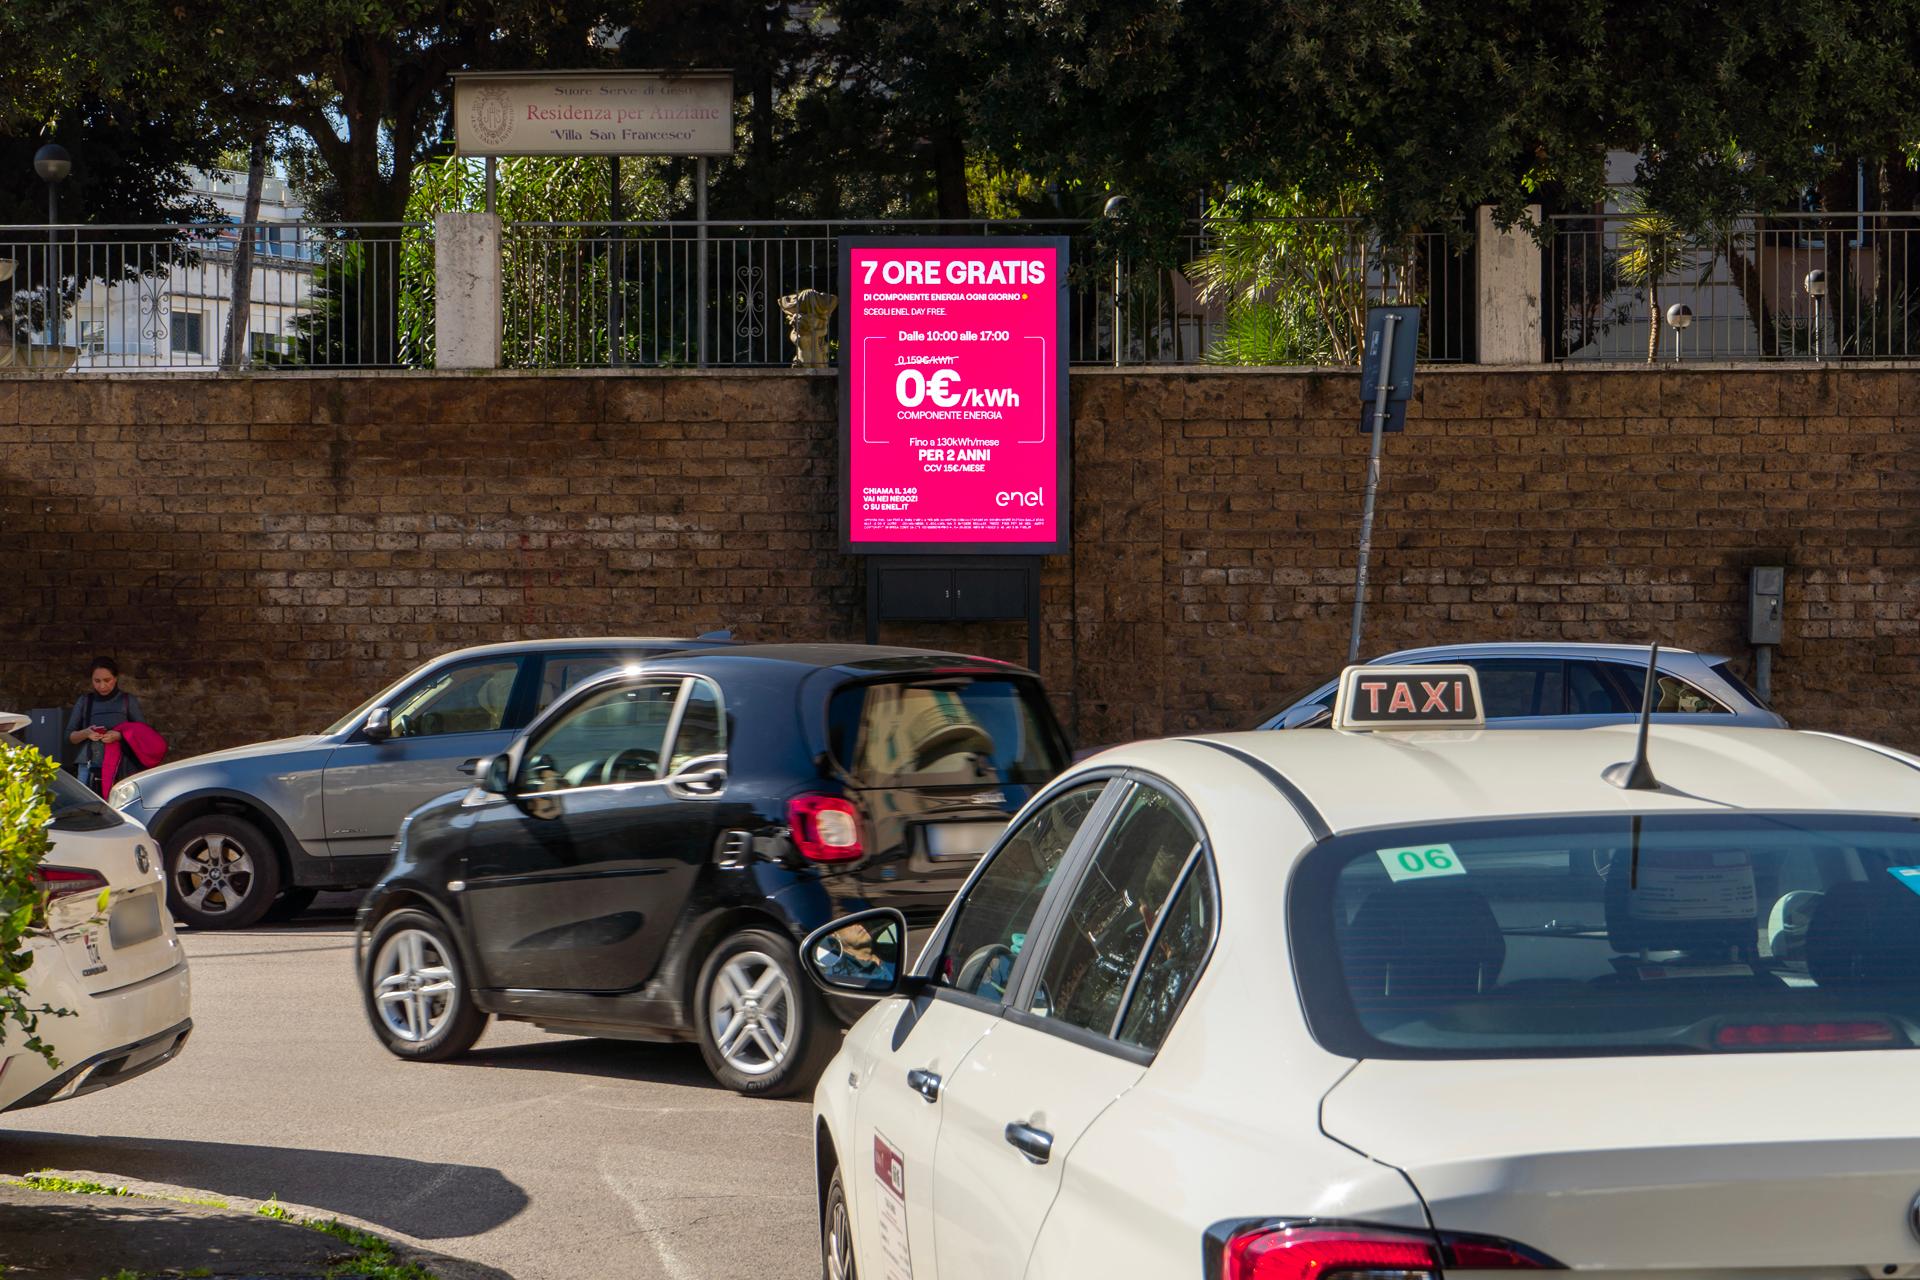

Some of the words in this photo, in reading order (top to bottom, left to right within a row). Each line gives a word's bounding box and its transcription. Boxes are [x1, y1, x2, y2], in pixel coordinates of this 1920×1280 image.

[554, 86, 593, 97] Suore
[600, 86, 637, 97] Serve
[527, 104, 611, 121] Residenza
[617, 107, 644, 124] per
[651, 104, 720, 120] Anziane
[589, 128, 616, 141] San
[861, 260, 878, 285] 7
[882, 260, 941, 285] ORE
[945, 260, 1046, 285] GRATIS
[864, 293, 873, 301] DI
[873, 293, 930, 301] COMPONENTE
[930, 293, 965, 301] ENERGIA
[965, 293, 987, 301] OGNI
[987, 293, 1021, 301] GIORNO
[863, 307, 890, 316] SCEGLI
[891, 307, 910, 316] ENEL
[911, 307, 926, 316] DAY
[898, 330, 925, 342] Dalle
[926, 330, 958, 342] 10:00
[959, 330, 978, 342] alle
[979, 330, 1010, 342] 17:00
[897, 410, 962, 421] COMPONENTE
[963, 410, 1003, 421] ENERGIA
[909, 437, 929, 447] Fino
[930, 437, 936, 447] a
[936, 436, 1000, 448] 130kWh/mese
[918, 449, 945, 461] PER
[946, 449, 955, 461] 2
[957, 449, 991, 461] ANNI
[923, 463, 942, 473] CCV
[863, 486, 894, 495] CHIAMA
[895, 486, 902, 495] IL
[903, 486, 918, 495] 140
[995, 486, 1045, 507] enel
[863, 494, 876, 503] VAI
[876, 494, 889, 503] NEI
[890, 494, 918, 503] NEGOZI
[863, 502, 870, 511] O
[870, 502, 881, 511] SU
[881, 502, 910, 511] ENEL.IT
[1361, 681, 1464, 714] TAXI
[1397, 848, 1453, 873] 06
